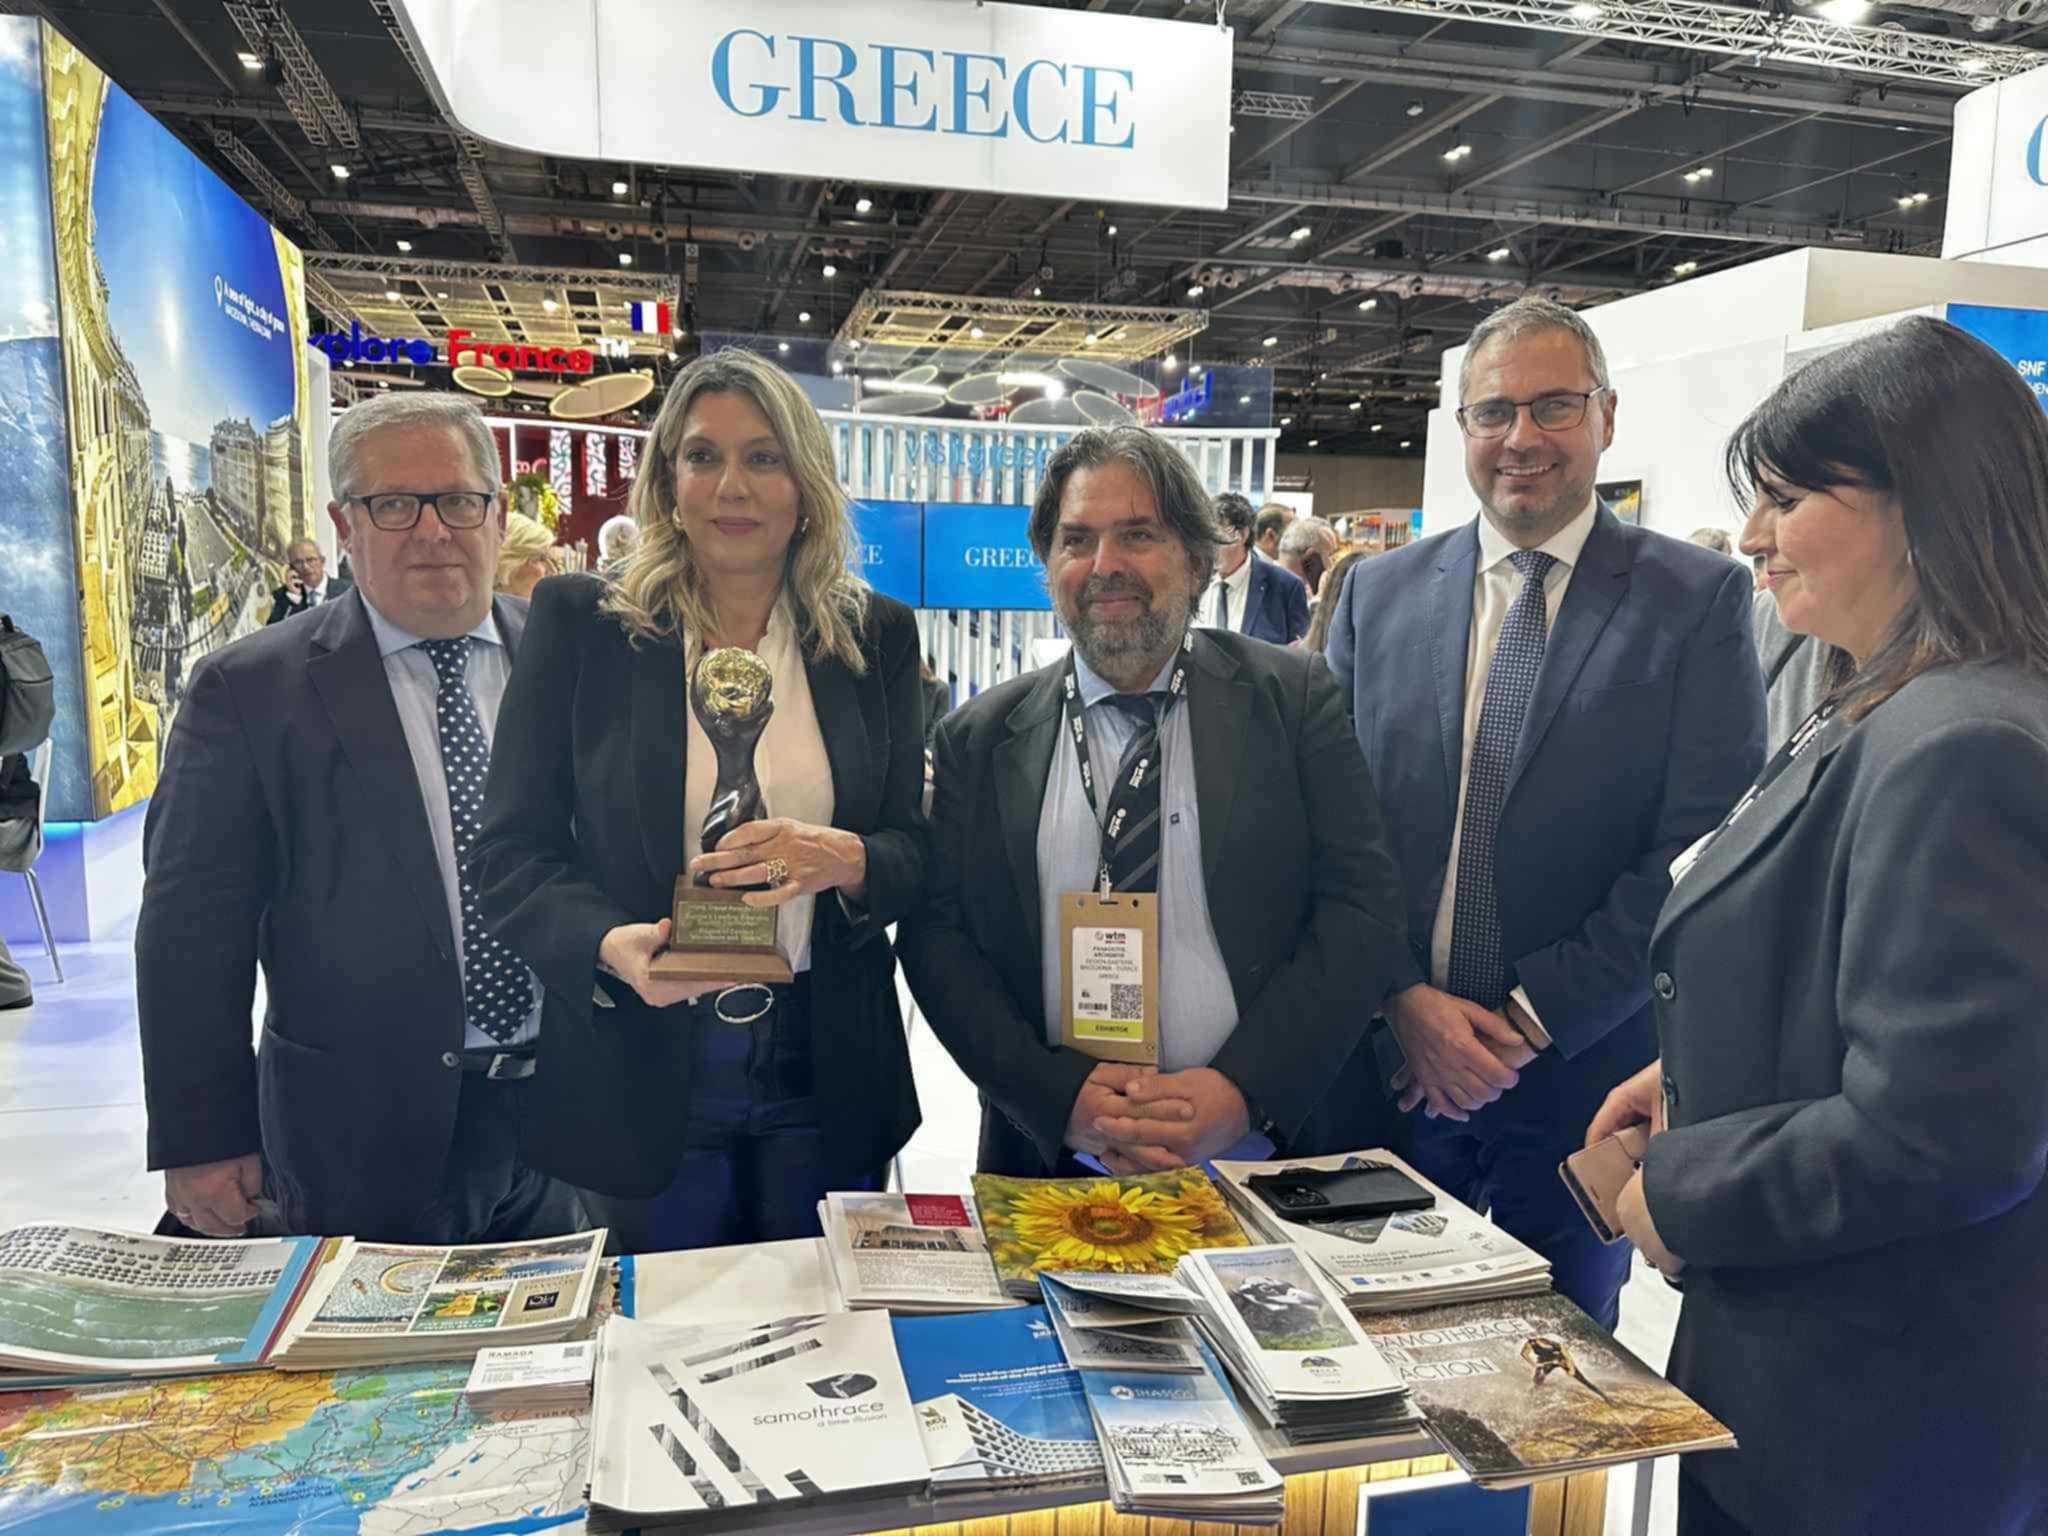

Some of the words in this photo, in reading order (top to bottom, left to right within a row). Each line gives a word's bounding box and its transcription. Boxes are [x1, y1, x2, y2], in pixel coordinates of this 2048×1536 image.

[711, 28, 1135, 149] GREECE
[306, 319, 433, 365] plore
[448, 329, 593, 374] France
[597, 337, 629, 358] TM
[2017, 360, 2047, 377] SNF
[1105, 931, 1126, 941] wtm
[1371, 1320, 1529, 1349] SAMOTHRACE
[488, 1350, 534, 1358] RAMADA
[1400, 1359, 1494, 1380] ACTION
[752, 1402, 884, 1426] samothrace
[827, 1416, 850, 1426] time
[852, 1413, 888, 1424] illusion
